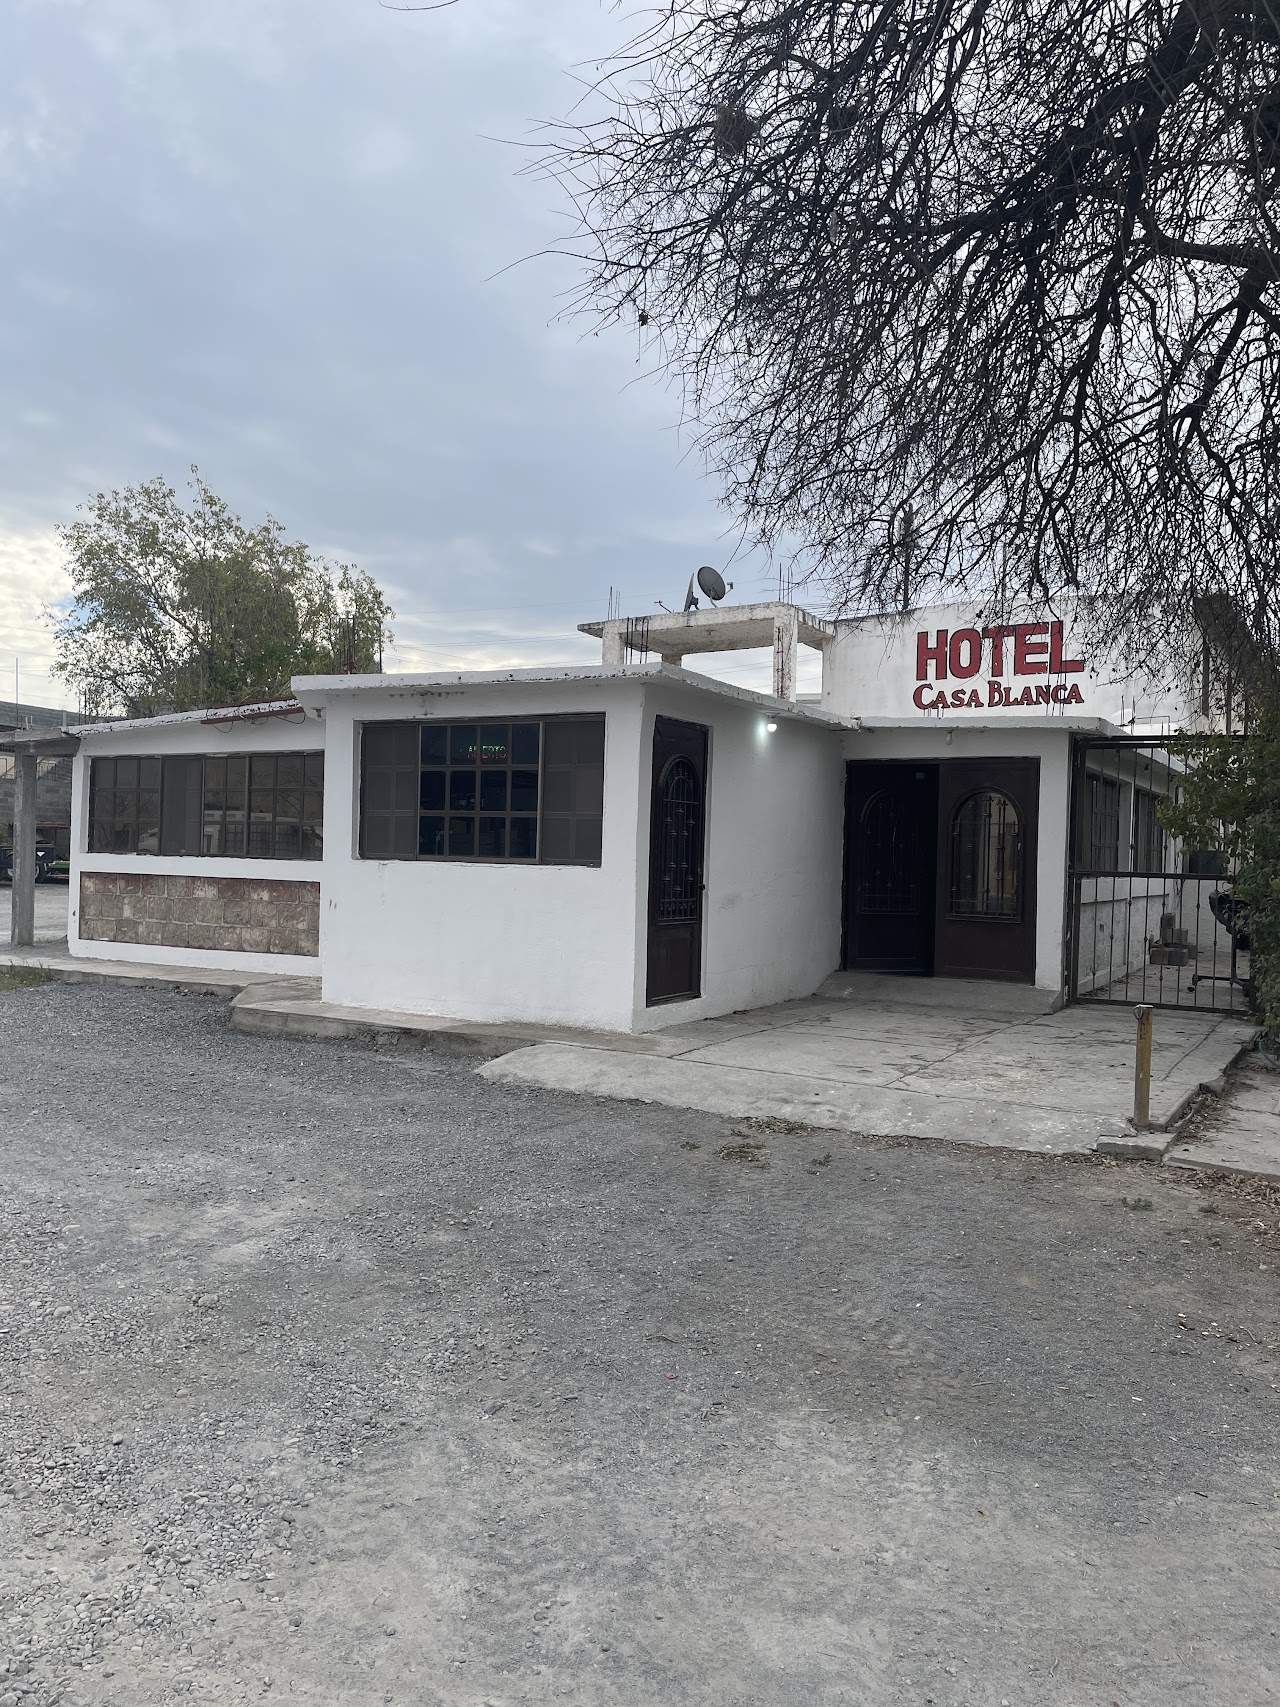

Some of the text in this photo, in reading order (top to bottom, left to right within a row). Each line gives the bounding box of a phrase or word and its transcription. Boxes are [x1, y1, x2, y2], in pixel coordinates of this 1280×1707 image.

[916, 620, 1085, 681] HOTEL
[913, 680, 1084, 710] CASA BLANCA
